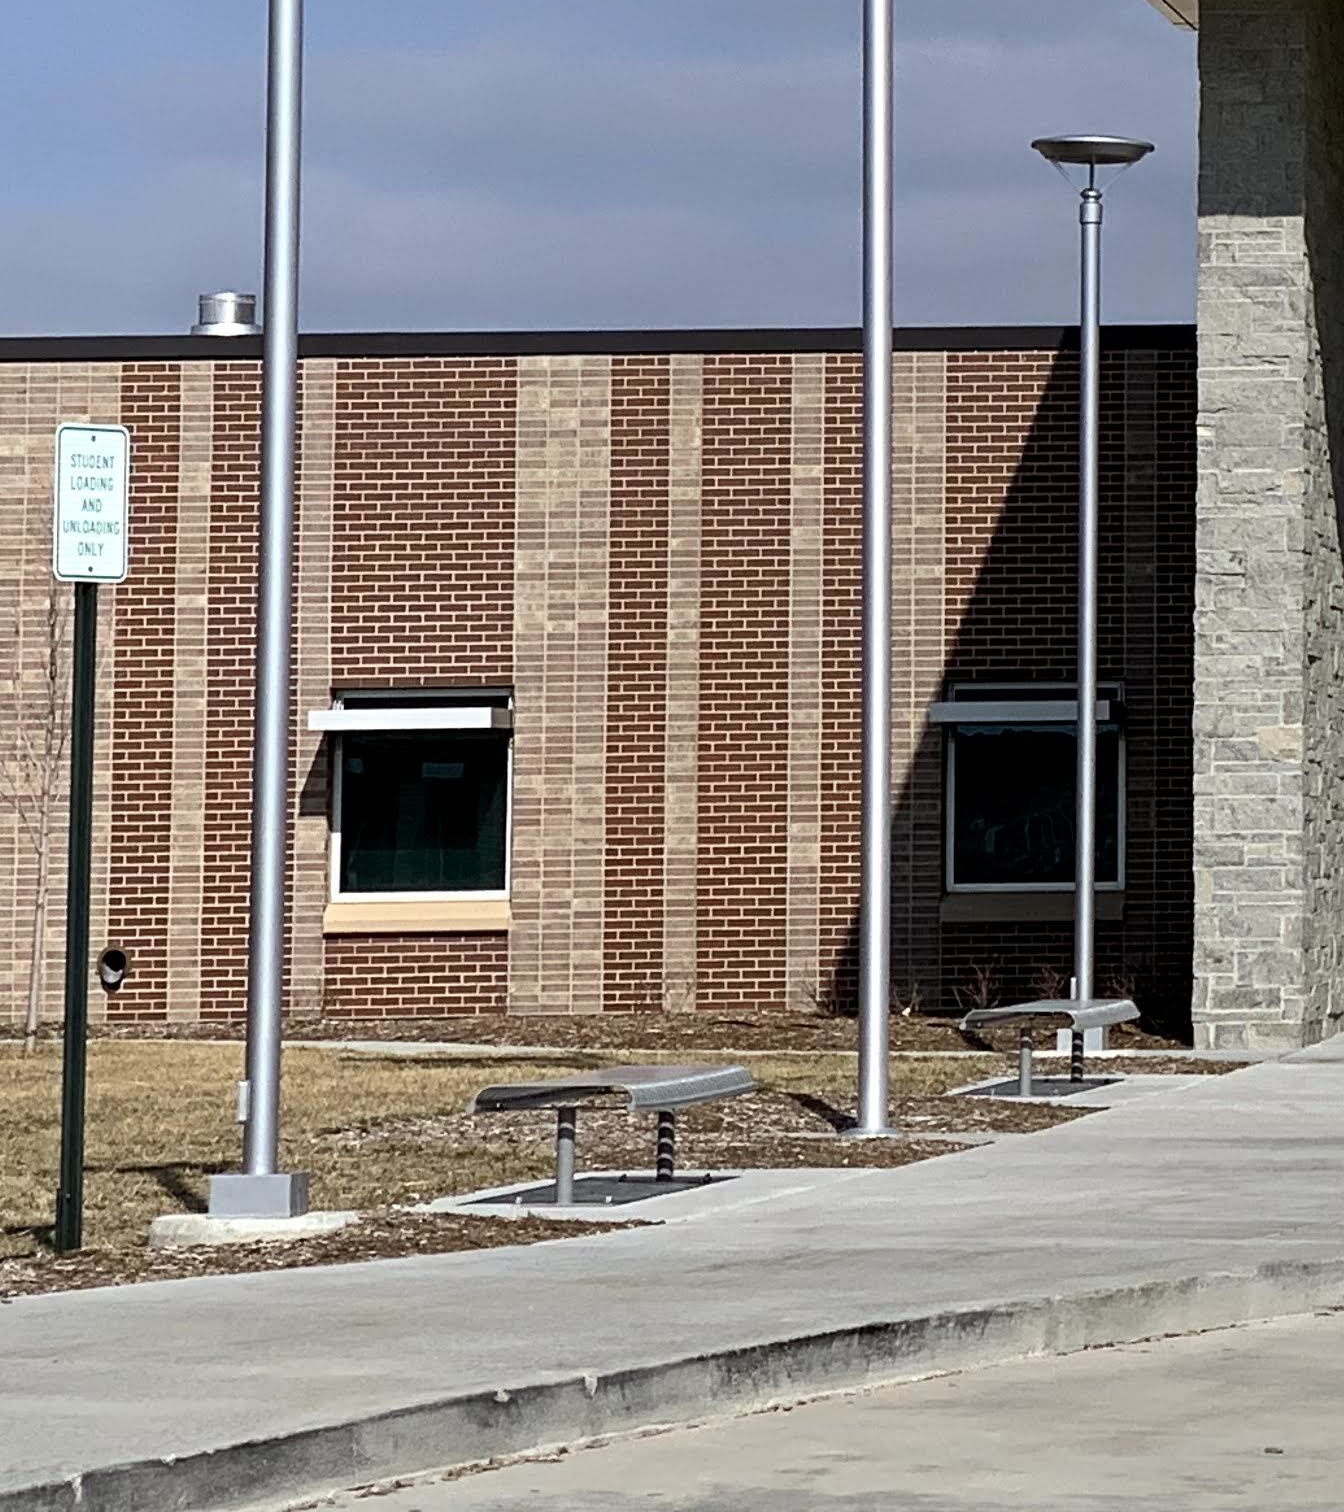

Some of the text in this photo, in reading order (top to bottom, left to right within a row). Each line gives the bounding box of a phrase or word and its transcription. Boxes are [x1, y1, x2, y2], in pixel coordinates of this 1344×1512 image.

[70, 454, 115, 469] STUDENT
[70, 476, 114, 491] LOADING
[81, 499, 103, 512] AND
[63, 520, 120, 535] UNLOADING
[77, 542, 104, 556] ONLY
